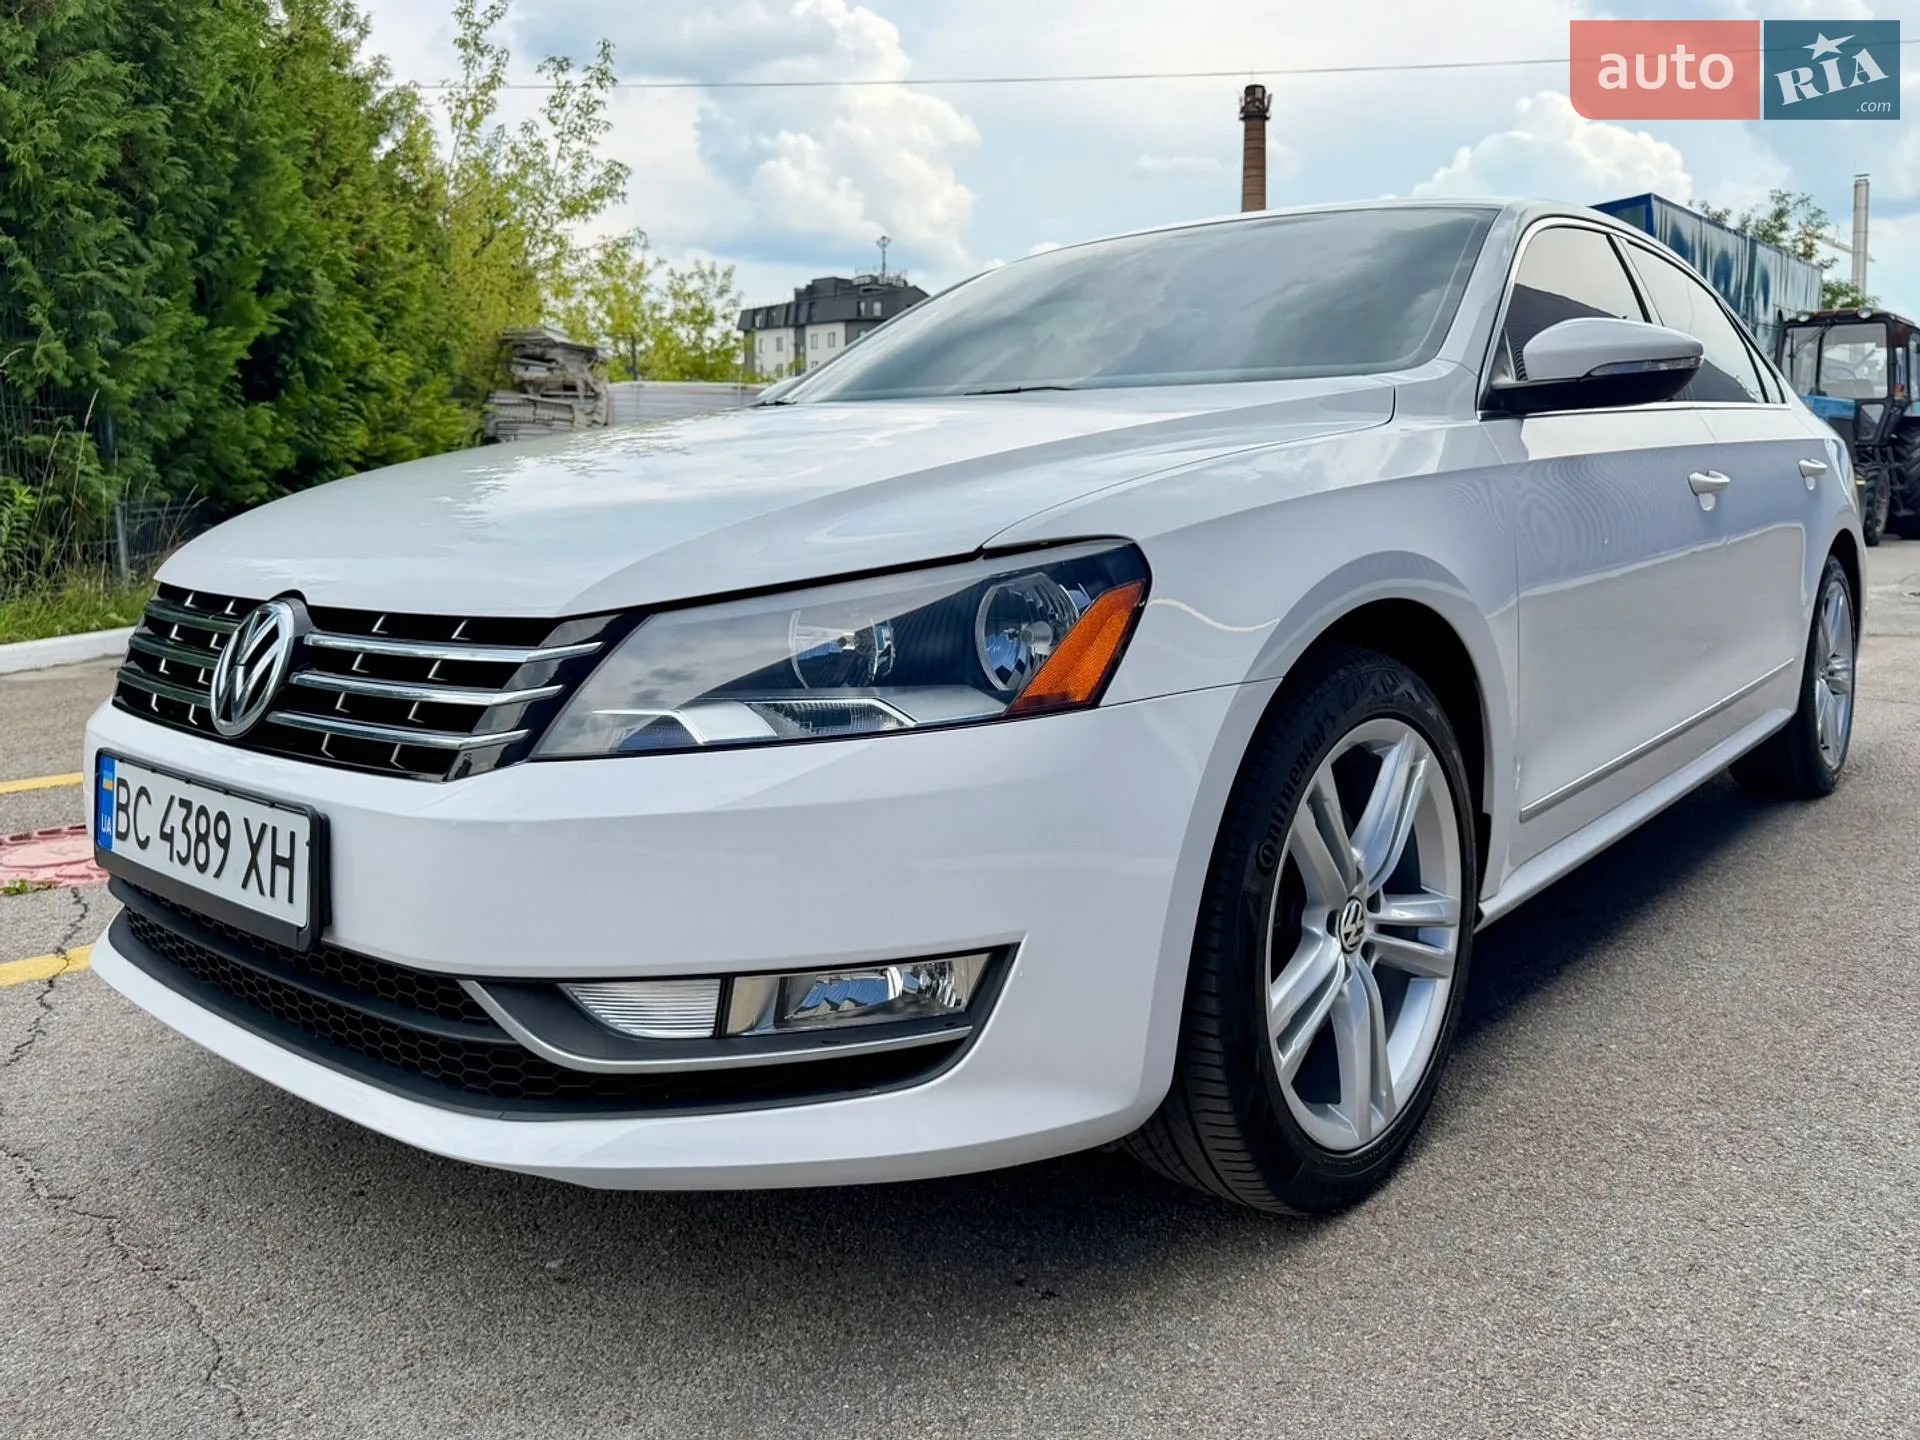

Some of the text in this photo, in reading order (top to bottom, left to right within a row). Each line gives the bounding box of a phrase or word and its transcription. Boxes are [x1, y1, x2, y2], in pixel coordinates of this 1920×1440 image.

[101, 812, 112, 837] UA
[115, 776, 297, 905] BC 4389 XH
[1256, 720, 1327, 877] Continental
